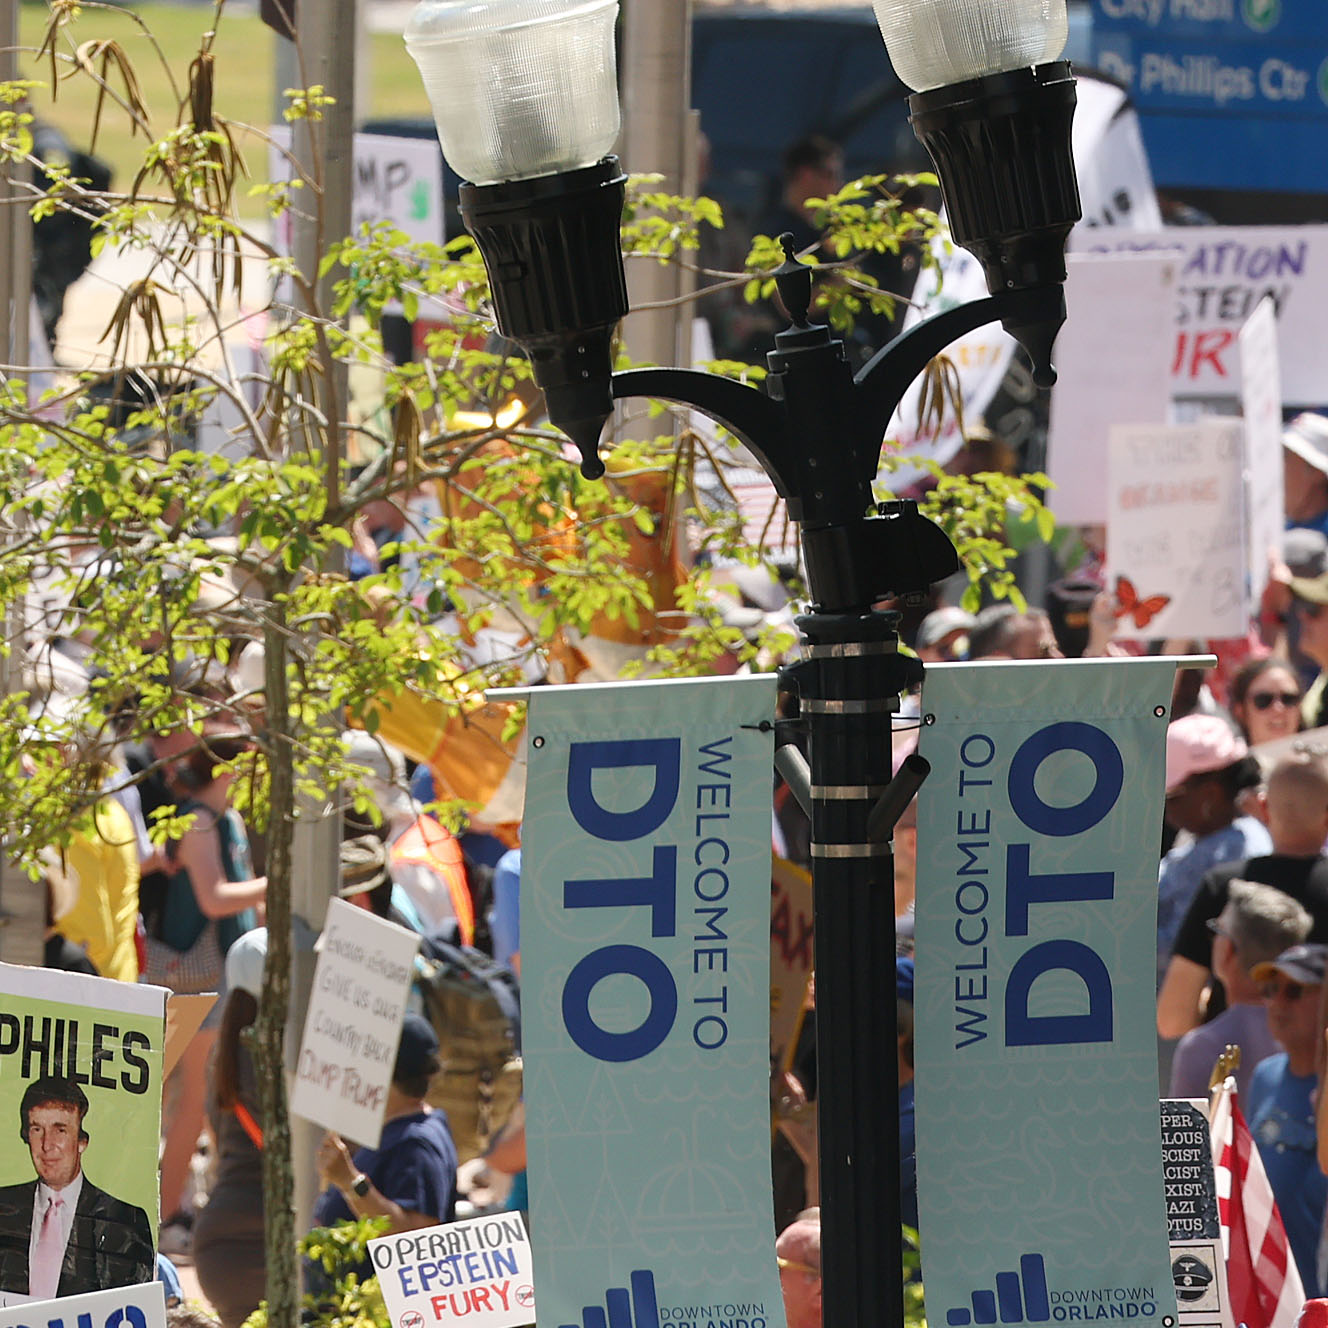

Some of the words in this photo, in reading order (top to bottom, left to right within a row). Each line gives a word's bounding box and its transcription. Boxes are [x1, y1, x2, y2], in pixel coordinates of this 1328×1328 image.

[1141, 53, 1252, 105] Phillips
[1259, 57, 1311, 101] Ctr
[960, 734, 995, 799] TO
[693, 737, 732, 973] WELCOME
[562, 737, 680, 1062] DTO
[1004, 721, 1124, 1046] DTO
[954, 808, 991, 1049] WELCOME
[693, 986, 728, 1049] TO
[374, 1219, 525, 1269] OPERATION
[397, 1248, 519, 1297] EPSTEIN
[1050, 1287, 1155, 1304] DOWNTOWN
[430, 1281, 511, 1321] FURY
[660, 1302, 765, 1320] DOWNTOWN
[1050, 1301, 1157, 1321] ORLANDO
